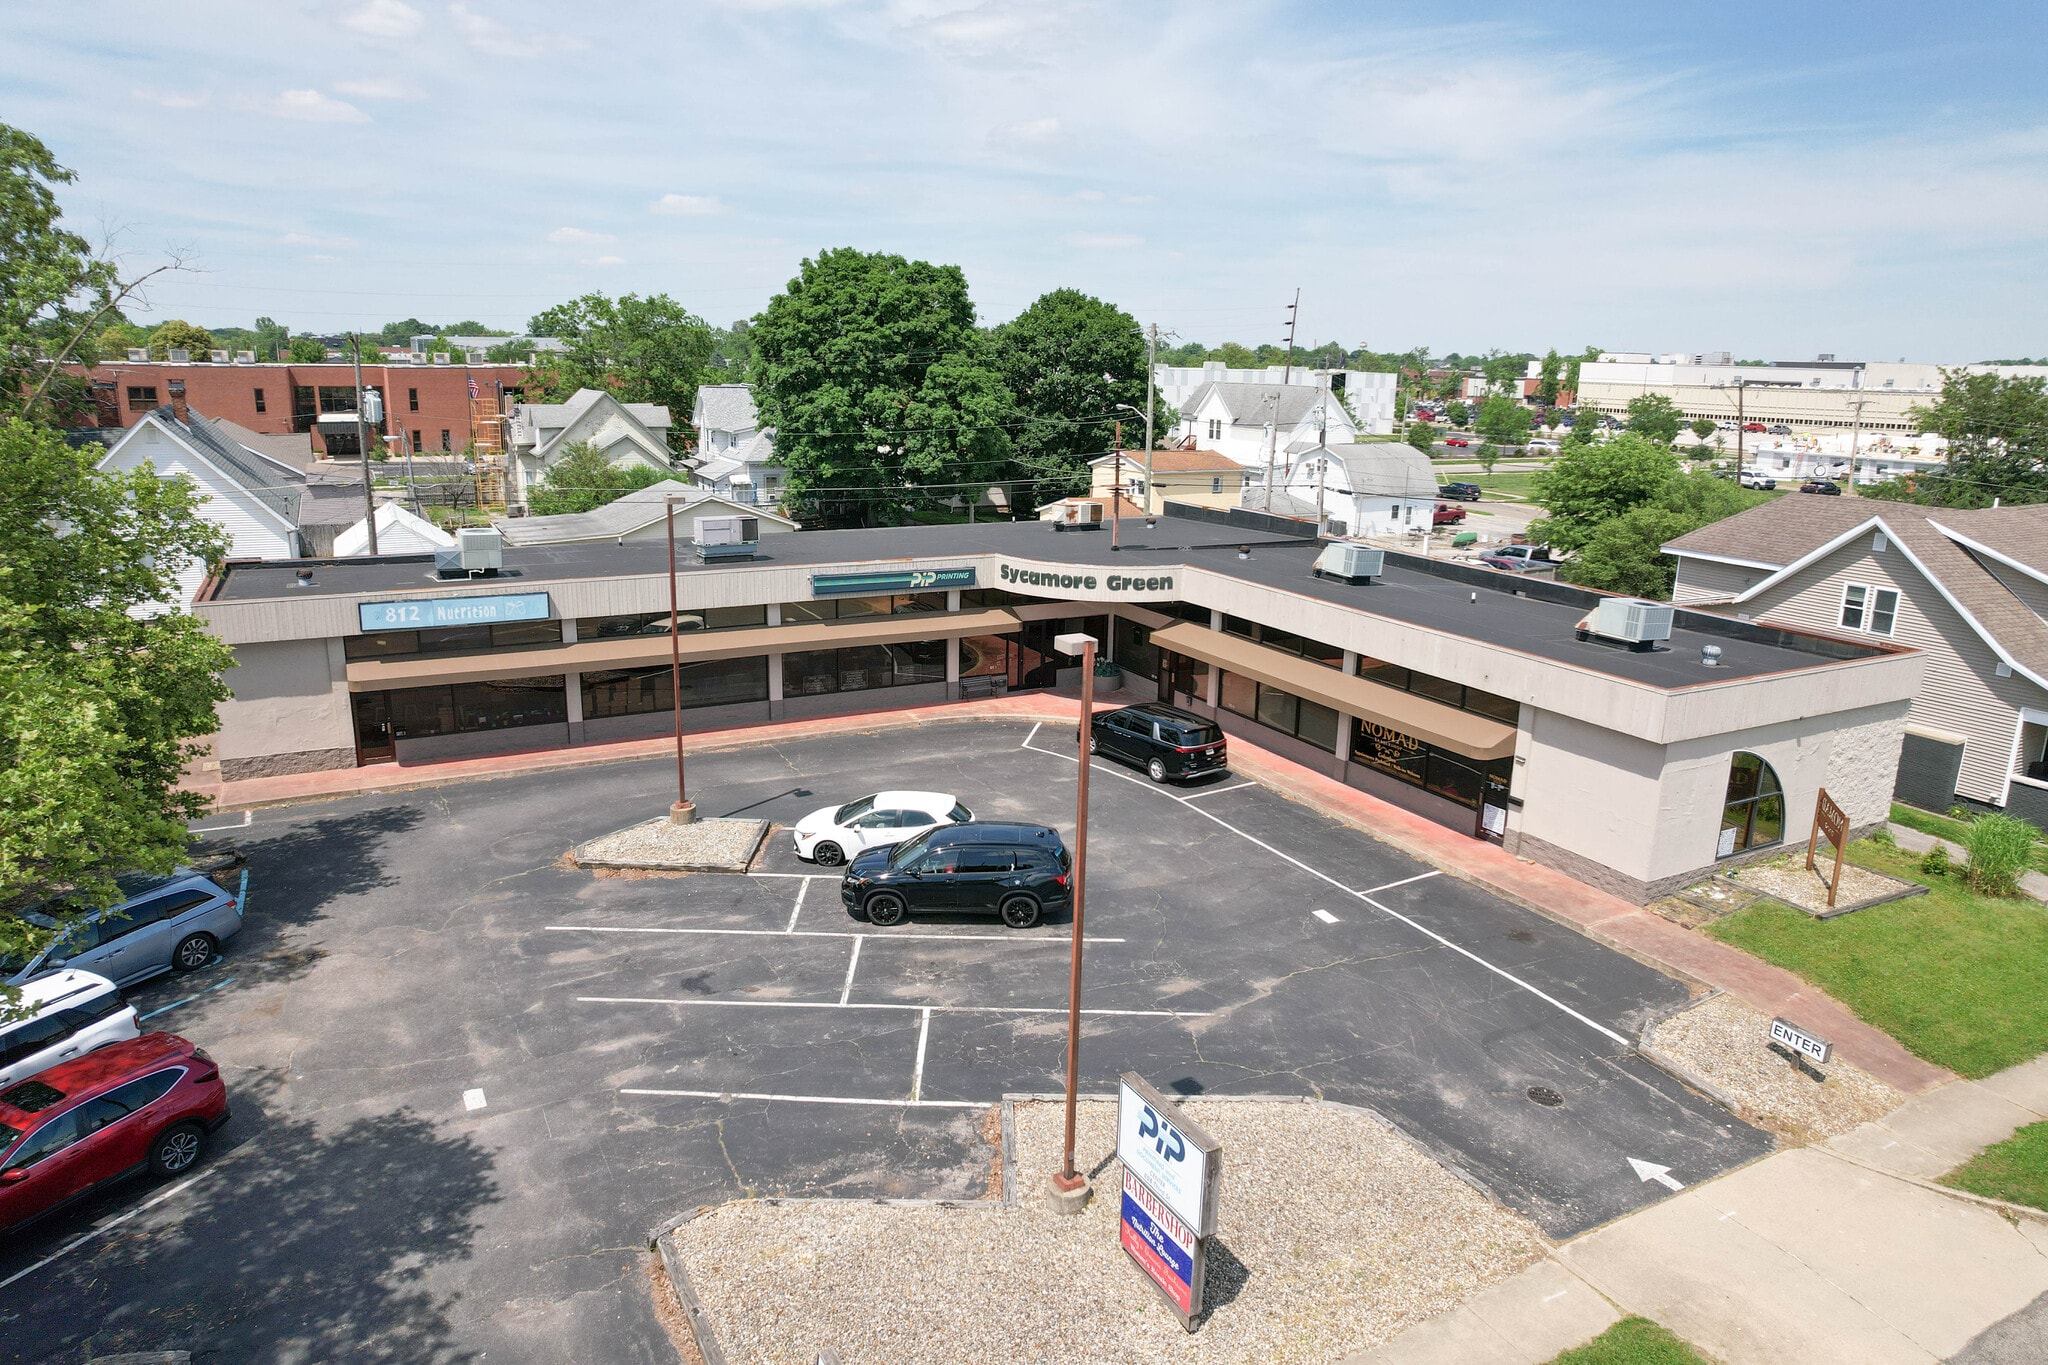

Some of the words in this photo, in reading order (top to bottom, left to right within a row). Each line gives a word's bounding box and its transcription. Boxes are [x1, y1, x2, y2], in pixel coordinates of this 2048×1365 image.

[937, 571, 970, 580] PRINTING
[1000, 564, 1097, 589] Sycamore
[1106, 575, 1173, 591] Green
[385, 605, 421, 623] 812
[437, 604, 497, 621] Nutrition
[1360, 719, 1419, 751] NOMAD
[1773, 1024, 1822, 1057] ENTER
[1125, 1171, 1193, 1249] BARBERSHOP
[1131, 1215, 1157, 1247] Nutrition
[1156, 1242, 1180, 1271] Lounge
[1150, 1221, 1165, 1244] The
